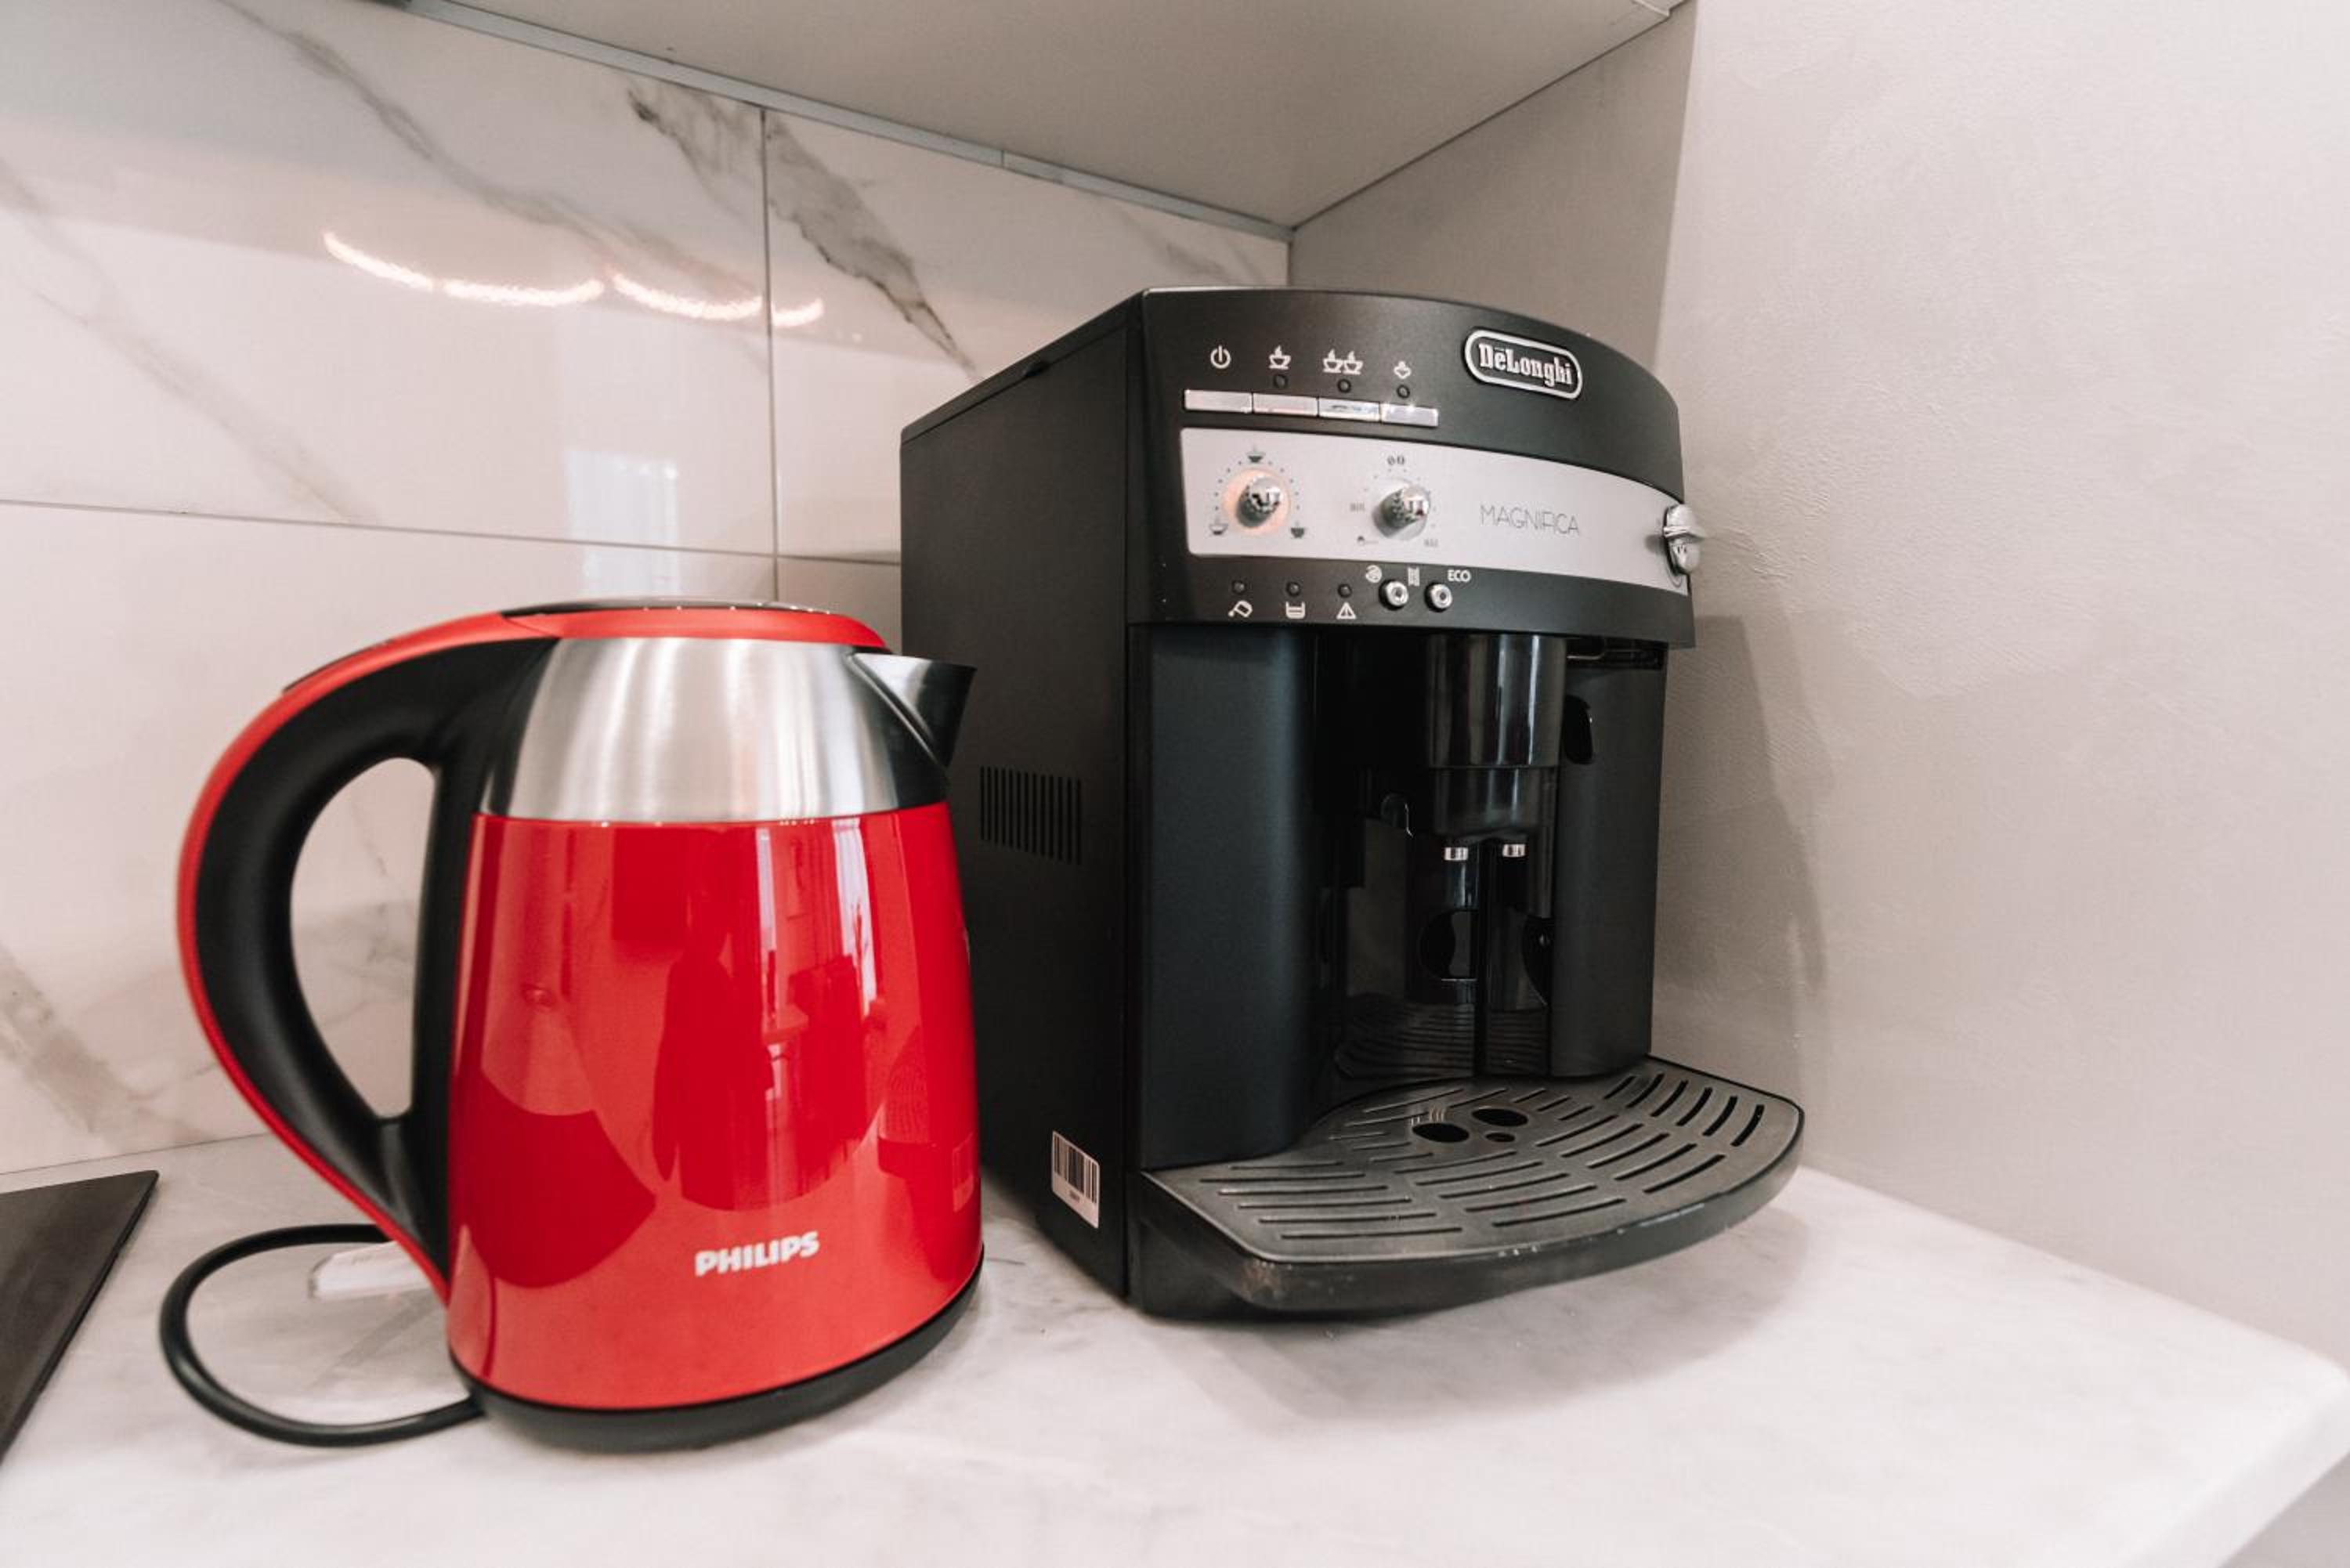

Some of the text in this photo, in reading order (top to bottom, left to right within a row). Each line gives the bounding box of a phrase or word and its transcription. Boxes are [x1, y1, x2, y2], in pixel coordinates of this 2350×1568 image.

[1480, 505, 1579, 534] MAGNIFICA
[1447, 569, 1471, 582] ECO
[695, 1230, 819, 1277] PHILIPS
